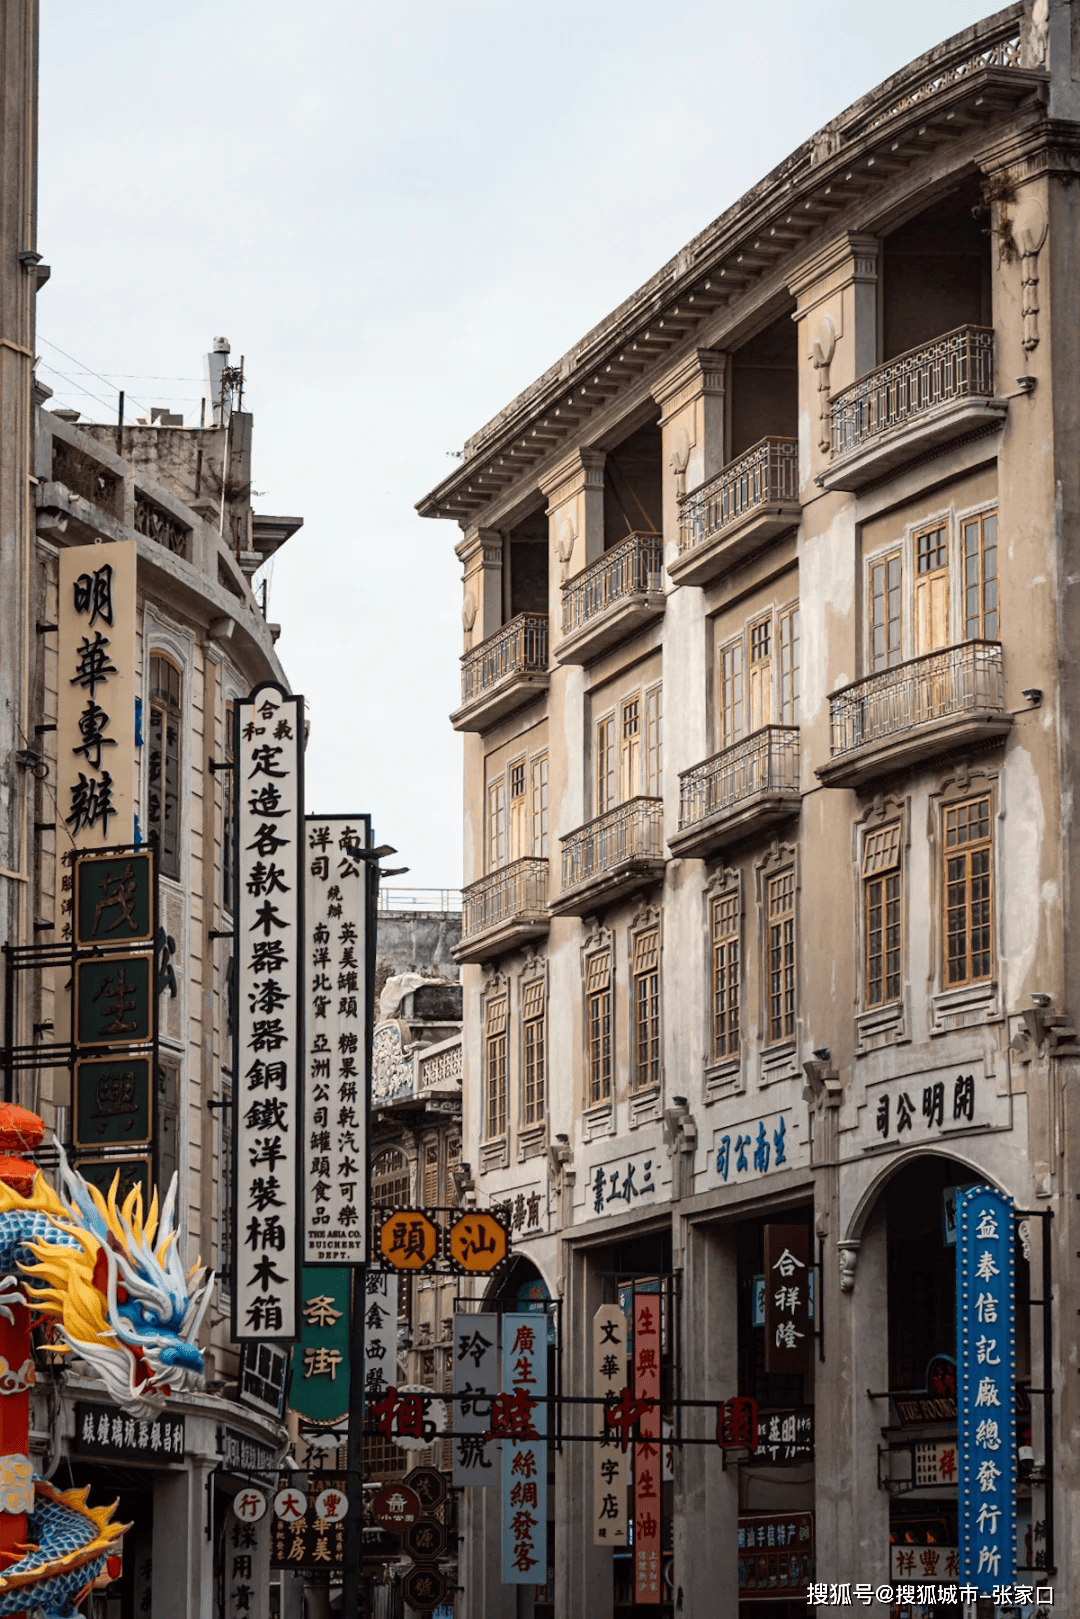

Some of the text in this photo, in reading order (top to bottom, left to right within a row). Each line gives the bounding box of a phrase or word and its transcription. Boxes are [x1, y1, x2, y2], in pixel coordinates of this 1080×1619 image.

[65, 563, 119, 839] 明華專辦
[243, 743, 291, 1332] 定造各款木器漆器銅鐵洋裝桶木箱
[308, 1230, 362, 1238] THE ASIA CO.
[318, 1251, 350, 1259] DEPT.
[772, 1247, 806, 1349] 合祥隆
[509, 1324, 540, 1574] 廣生絲綢發客
[973, 1208, 1003, 1578] 益奉信記廠總發行所
